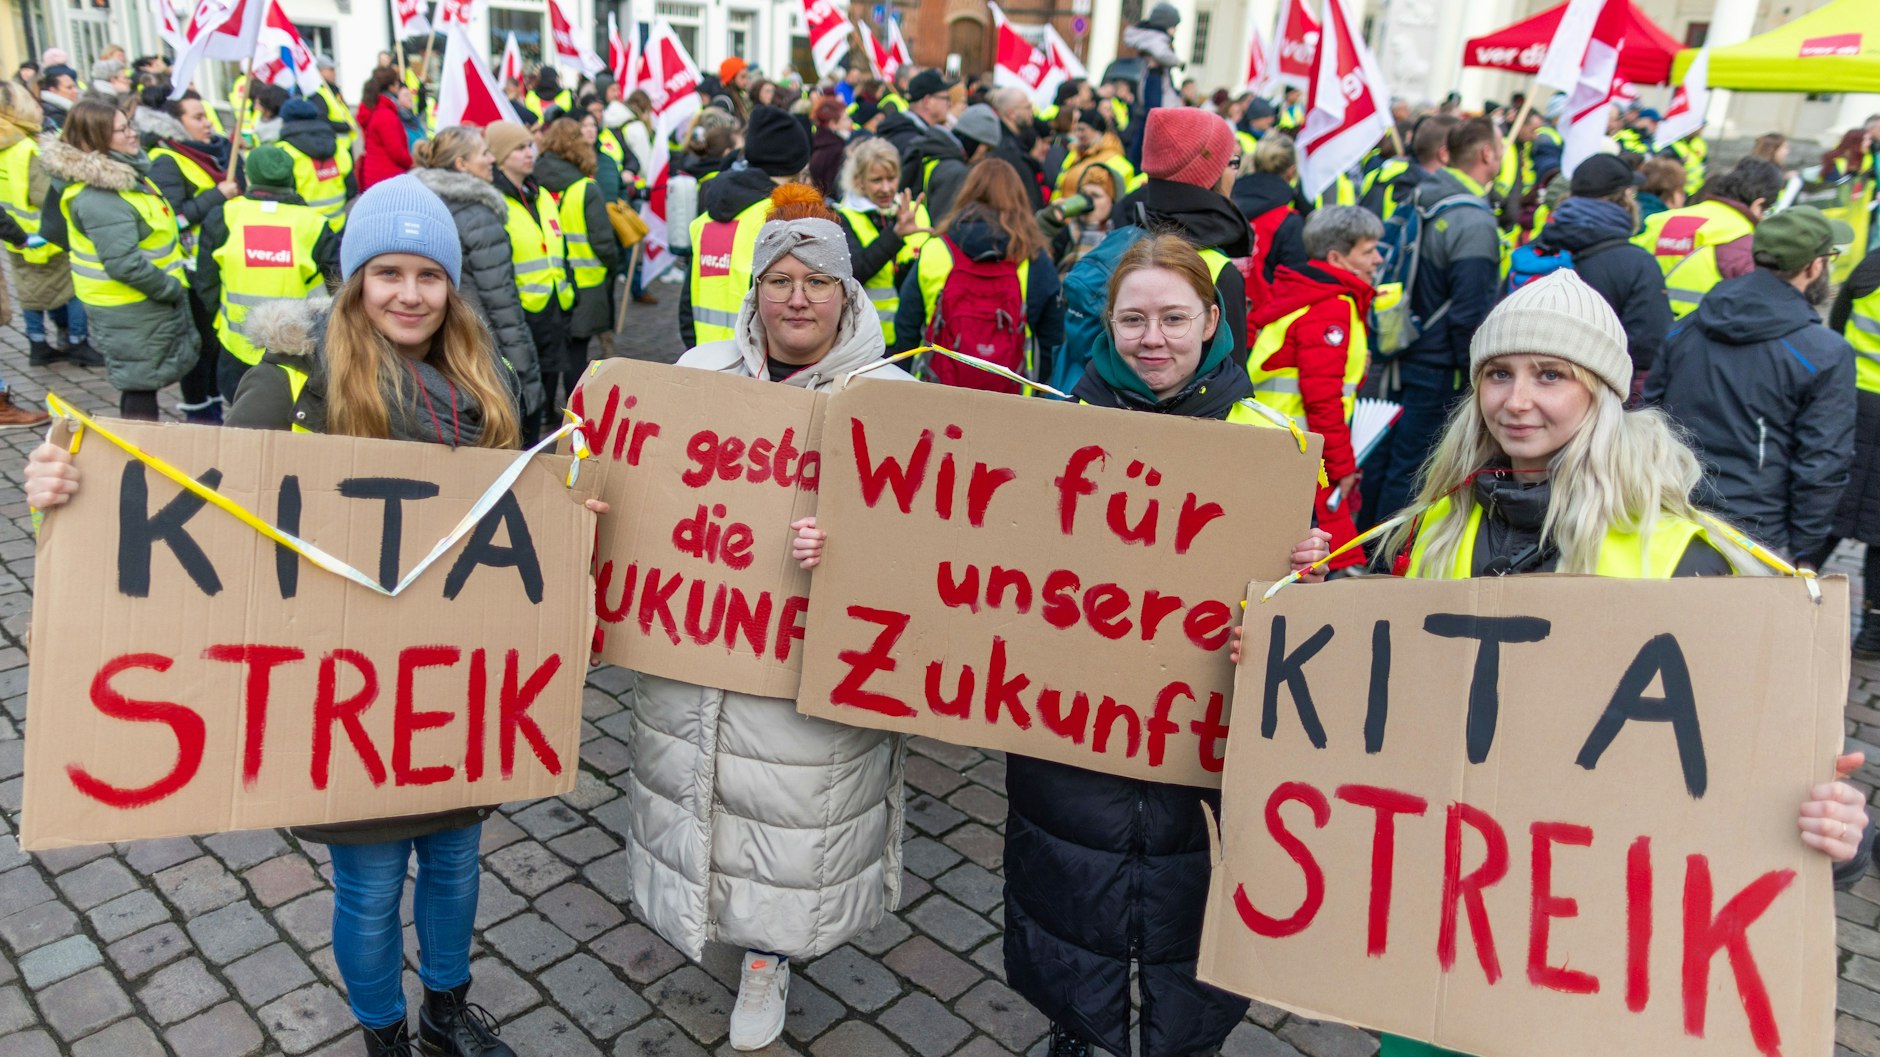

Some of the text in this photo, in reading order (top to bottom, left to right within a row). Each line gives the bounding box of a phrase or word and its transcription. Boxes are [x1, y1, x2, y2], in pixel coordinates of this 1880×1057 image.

[246, 248, 292, 263] ver.di
[700, 253, 732, 269] ver.di
[569, 384, 662, 467] Wir
[681, 427, 821, 495] gesta
[118, 459, 544, 605] KITA
[672, 503, 755, 571] die
[851, 417, 1225, 555] Wir für
[592, 558, 810, 663] UKUNF
[937, 561, 1232, 652] unsere
[65, 644, 562, 810] STREIK
[830, 605, 1229, 773] Zukunft
[1261, 614, 1707, 799] KITA
[1233, 781, 1798, 1057] STREIK
